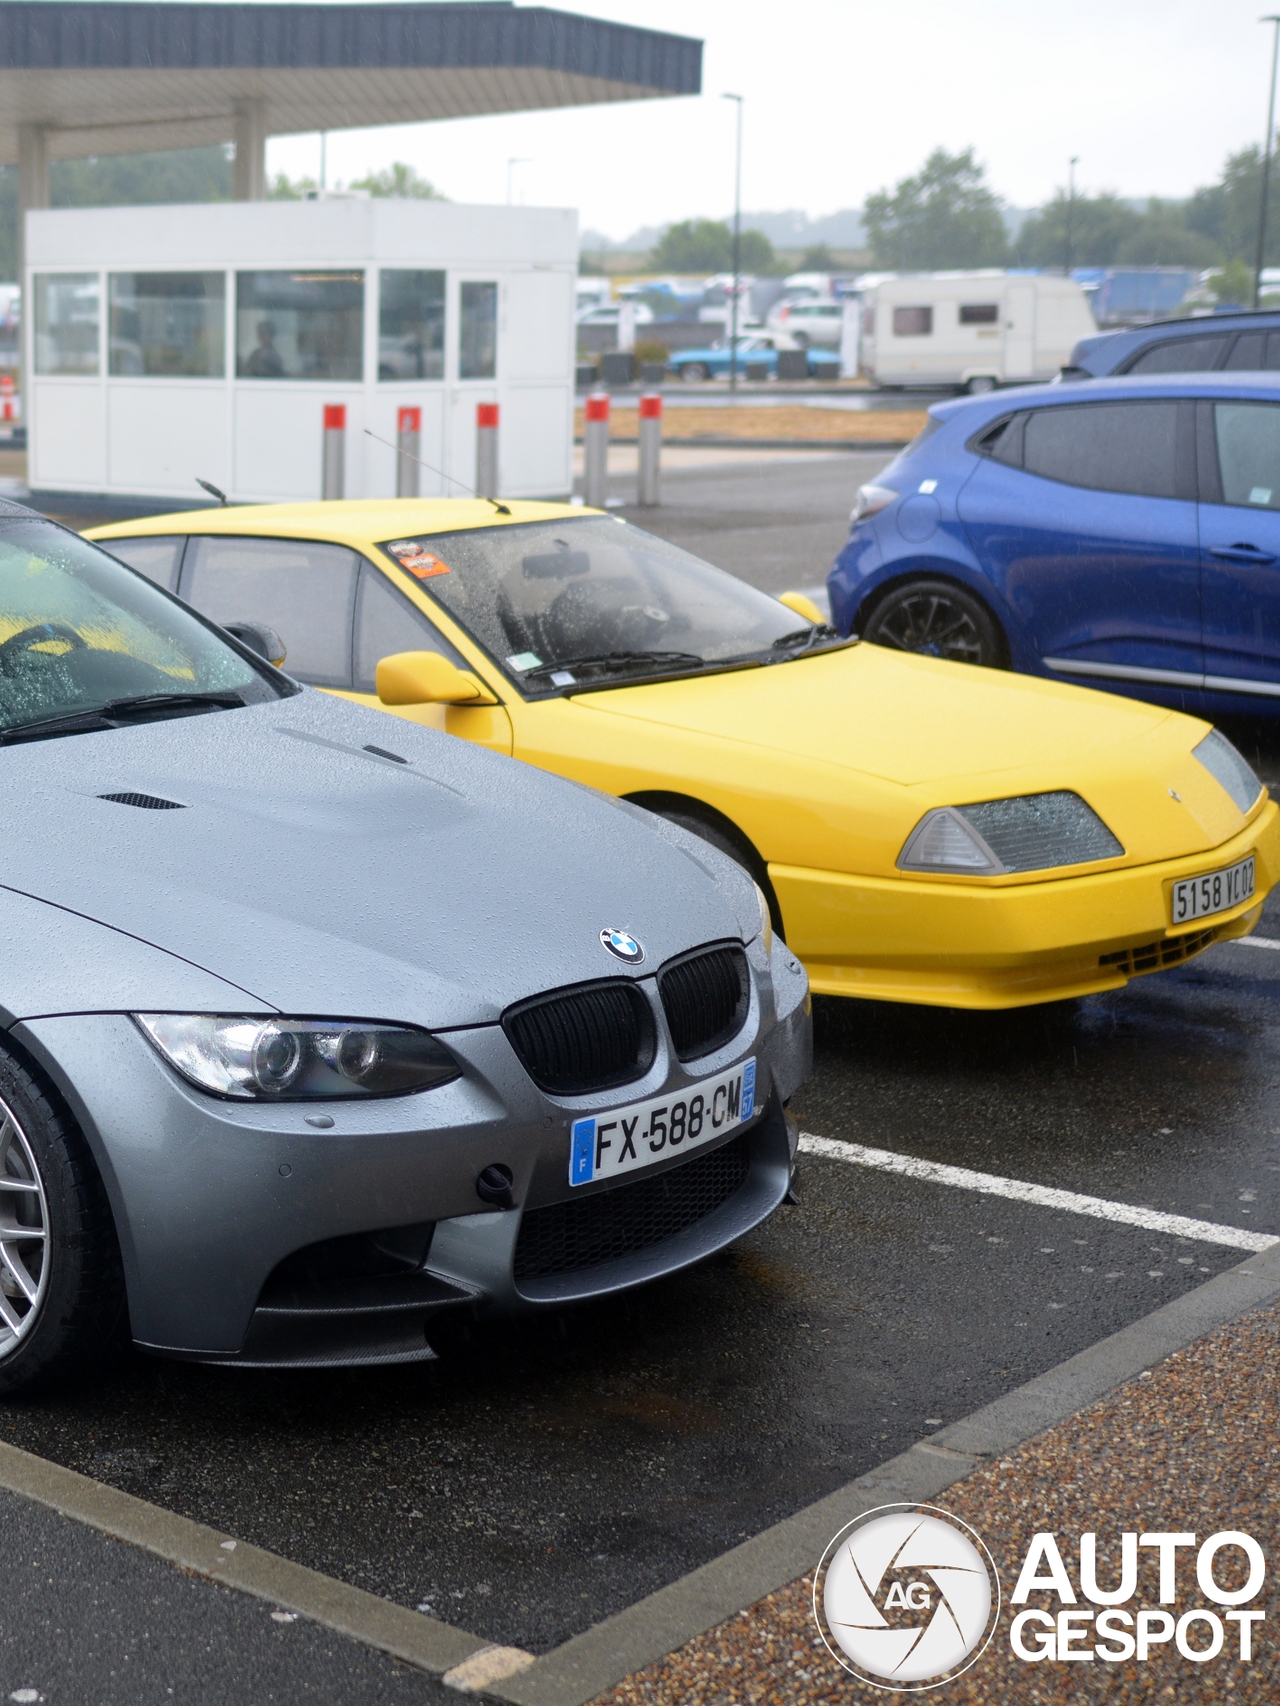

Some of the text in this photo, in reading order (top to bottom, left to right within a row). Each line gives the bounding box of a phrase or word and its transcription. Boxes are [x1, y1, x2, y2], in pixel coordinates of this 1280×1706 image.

[1178, 875, 1221, 918] 5158
[1242, 860, 1254, 896] 02
[595, 1076, 742, 1170] FX-588-CM
[742, 1093, 753, 1116] 57
[579, 1158, 587, 1173] F
